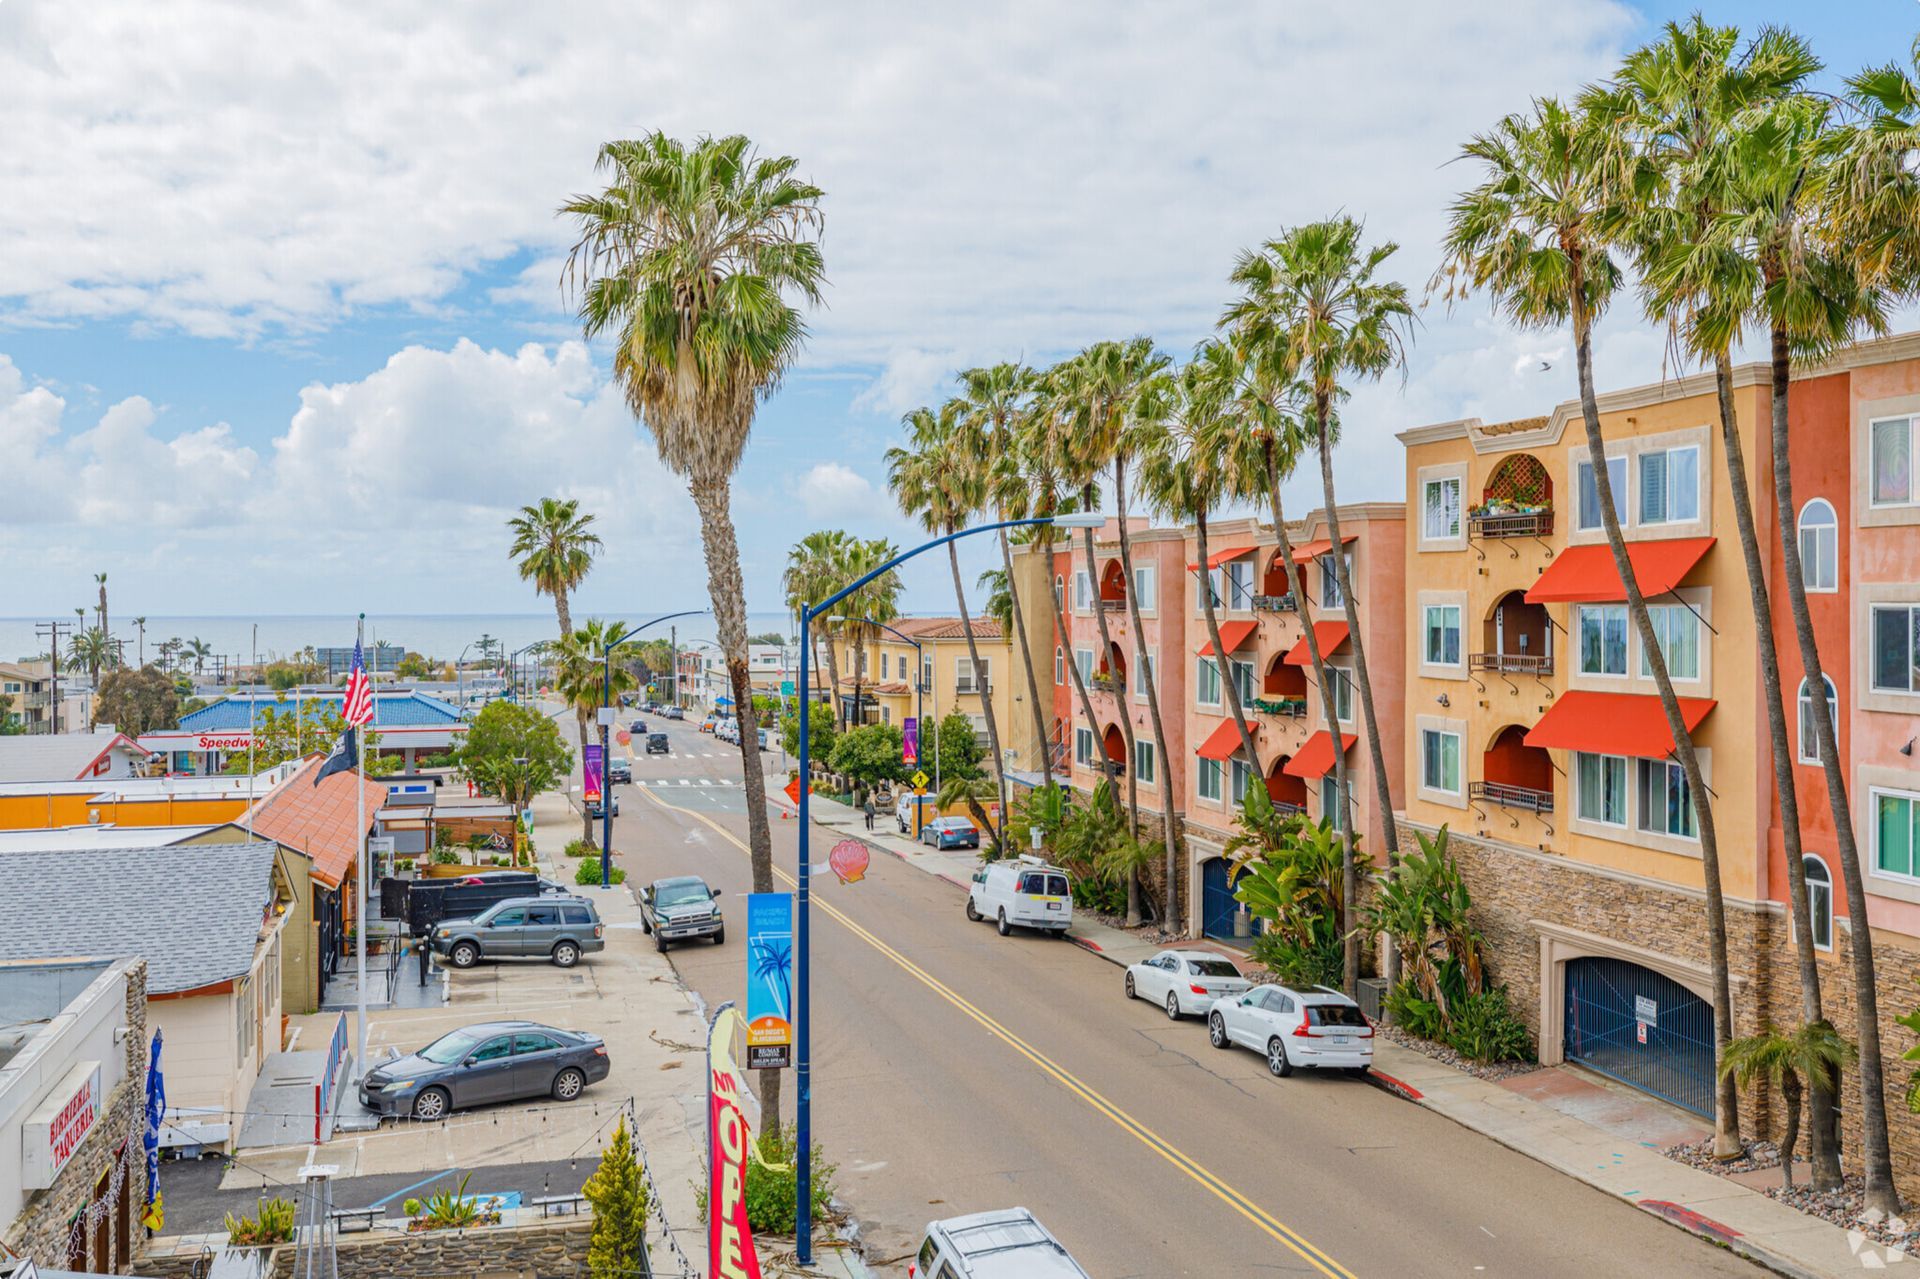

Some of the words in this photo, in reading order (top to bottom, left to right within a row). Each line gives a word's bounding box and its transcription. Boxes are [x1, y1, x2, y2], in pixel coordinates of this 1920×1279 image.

[50, 1080, 91, 1146] BIRRIERIA
[54, 1103, 94, 1169] TAQUERIA
[718, 1104, 749, 1279] OPE
